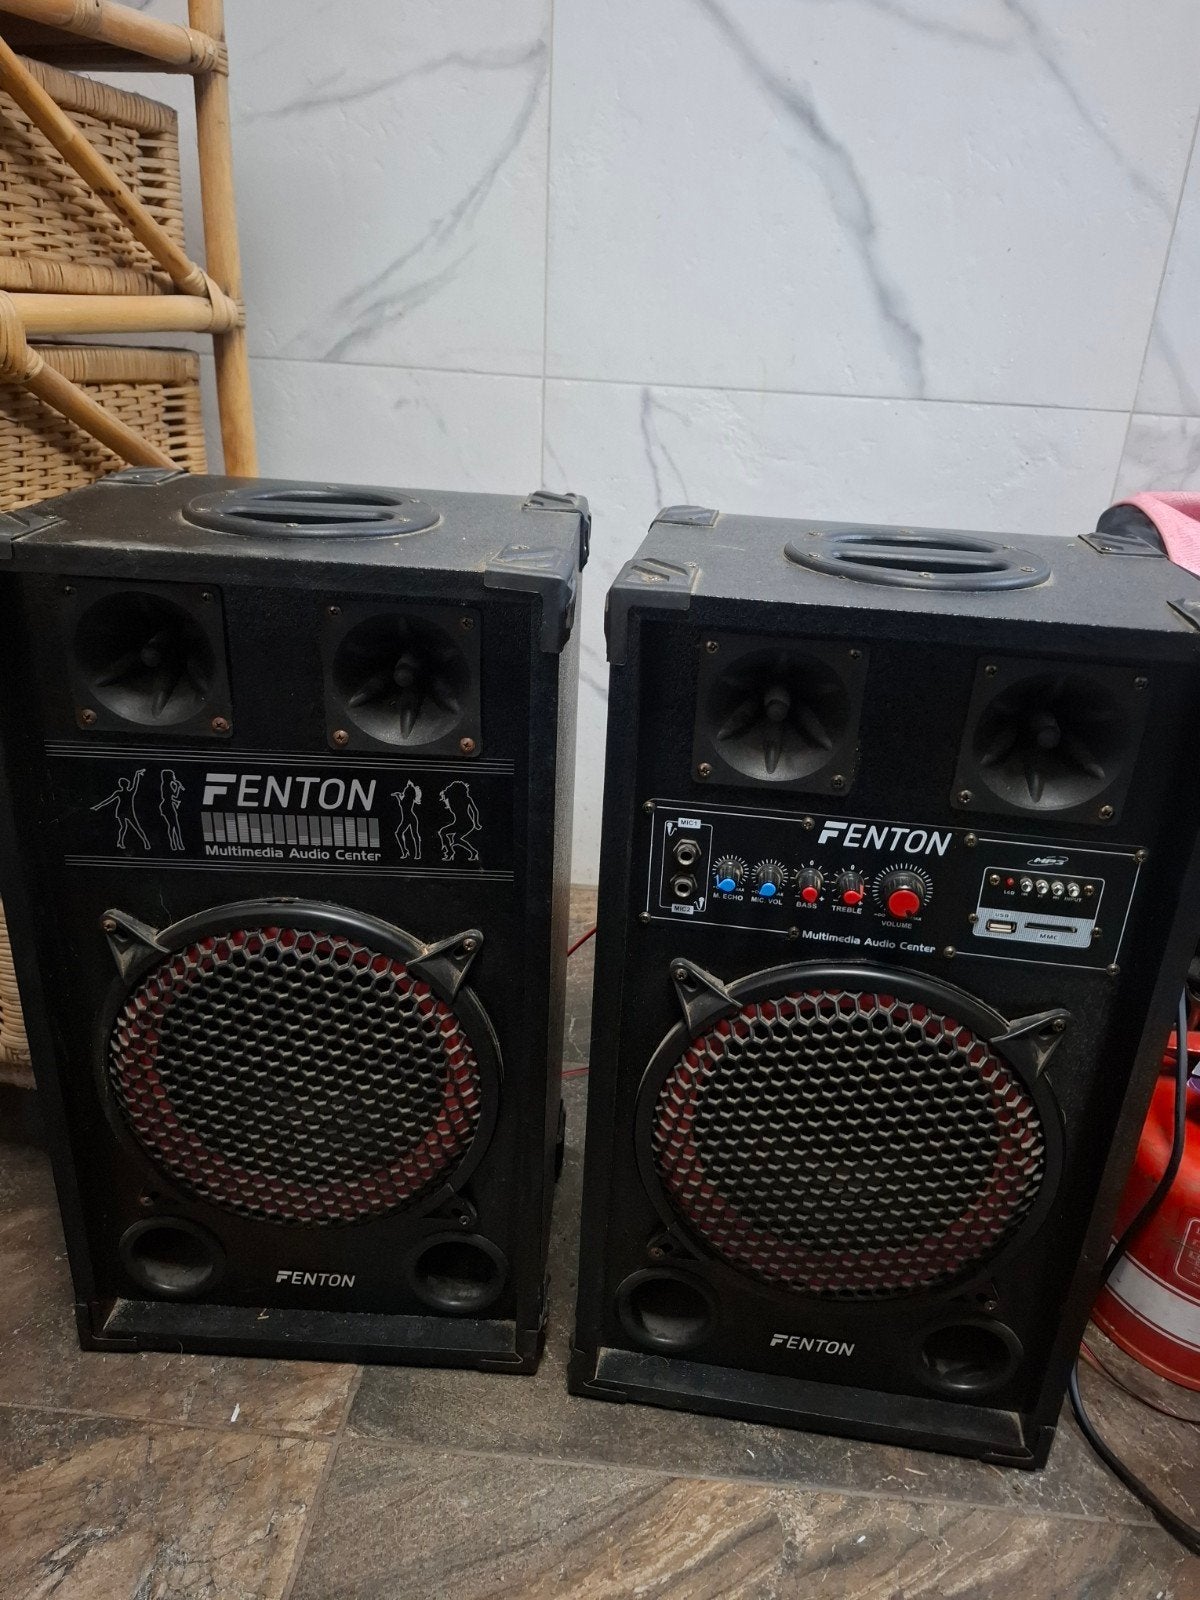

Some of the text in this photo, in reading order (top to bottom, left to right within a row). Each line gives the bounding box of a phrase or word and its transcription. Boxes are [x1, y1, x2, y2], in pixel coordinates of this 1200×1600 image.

[202, 772, 377, 812] FENTON
[680, 819, 699, 827] MIC1
[817, 820, 953, 857] FENTON
[204, 844, 382, 862] Multimedia Audio Center
[722, 893, 744, 901] ECHO
[768, 898, 783, 906] VOL
[673, 904, 692, 912] MIC2
[796, 901, 818, 909] BASS
[831, 905, 863, 915] TREBLE
[881, 920, 913, 930] VOLUME
[802, 930, 936, 953] Multimedia Audio Center
[275, 1270, 356, 1288] FENTON
[769, 1333, 856, 1357] FENTON
